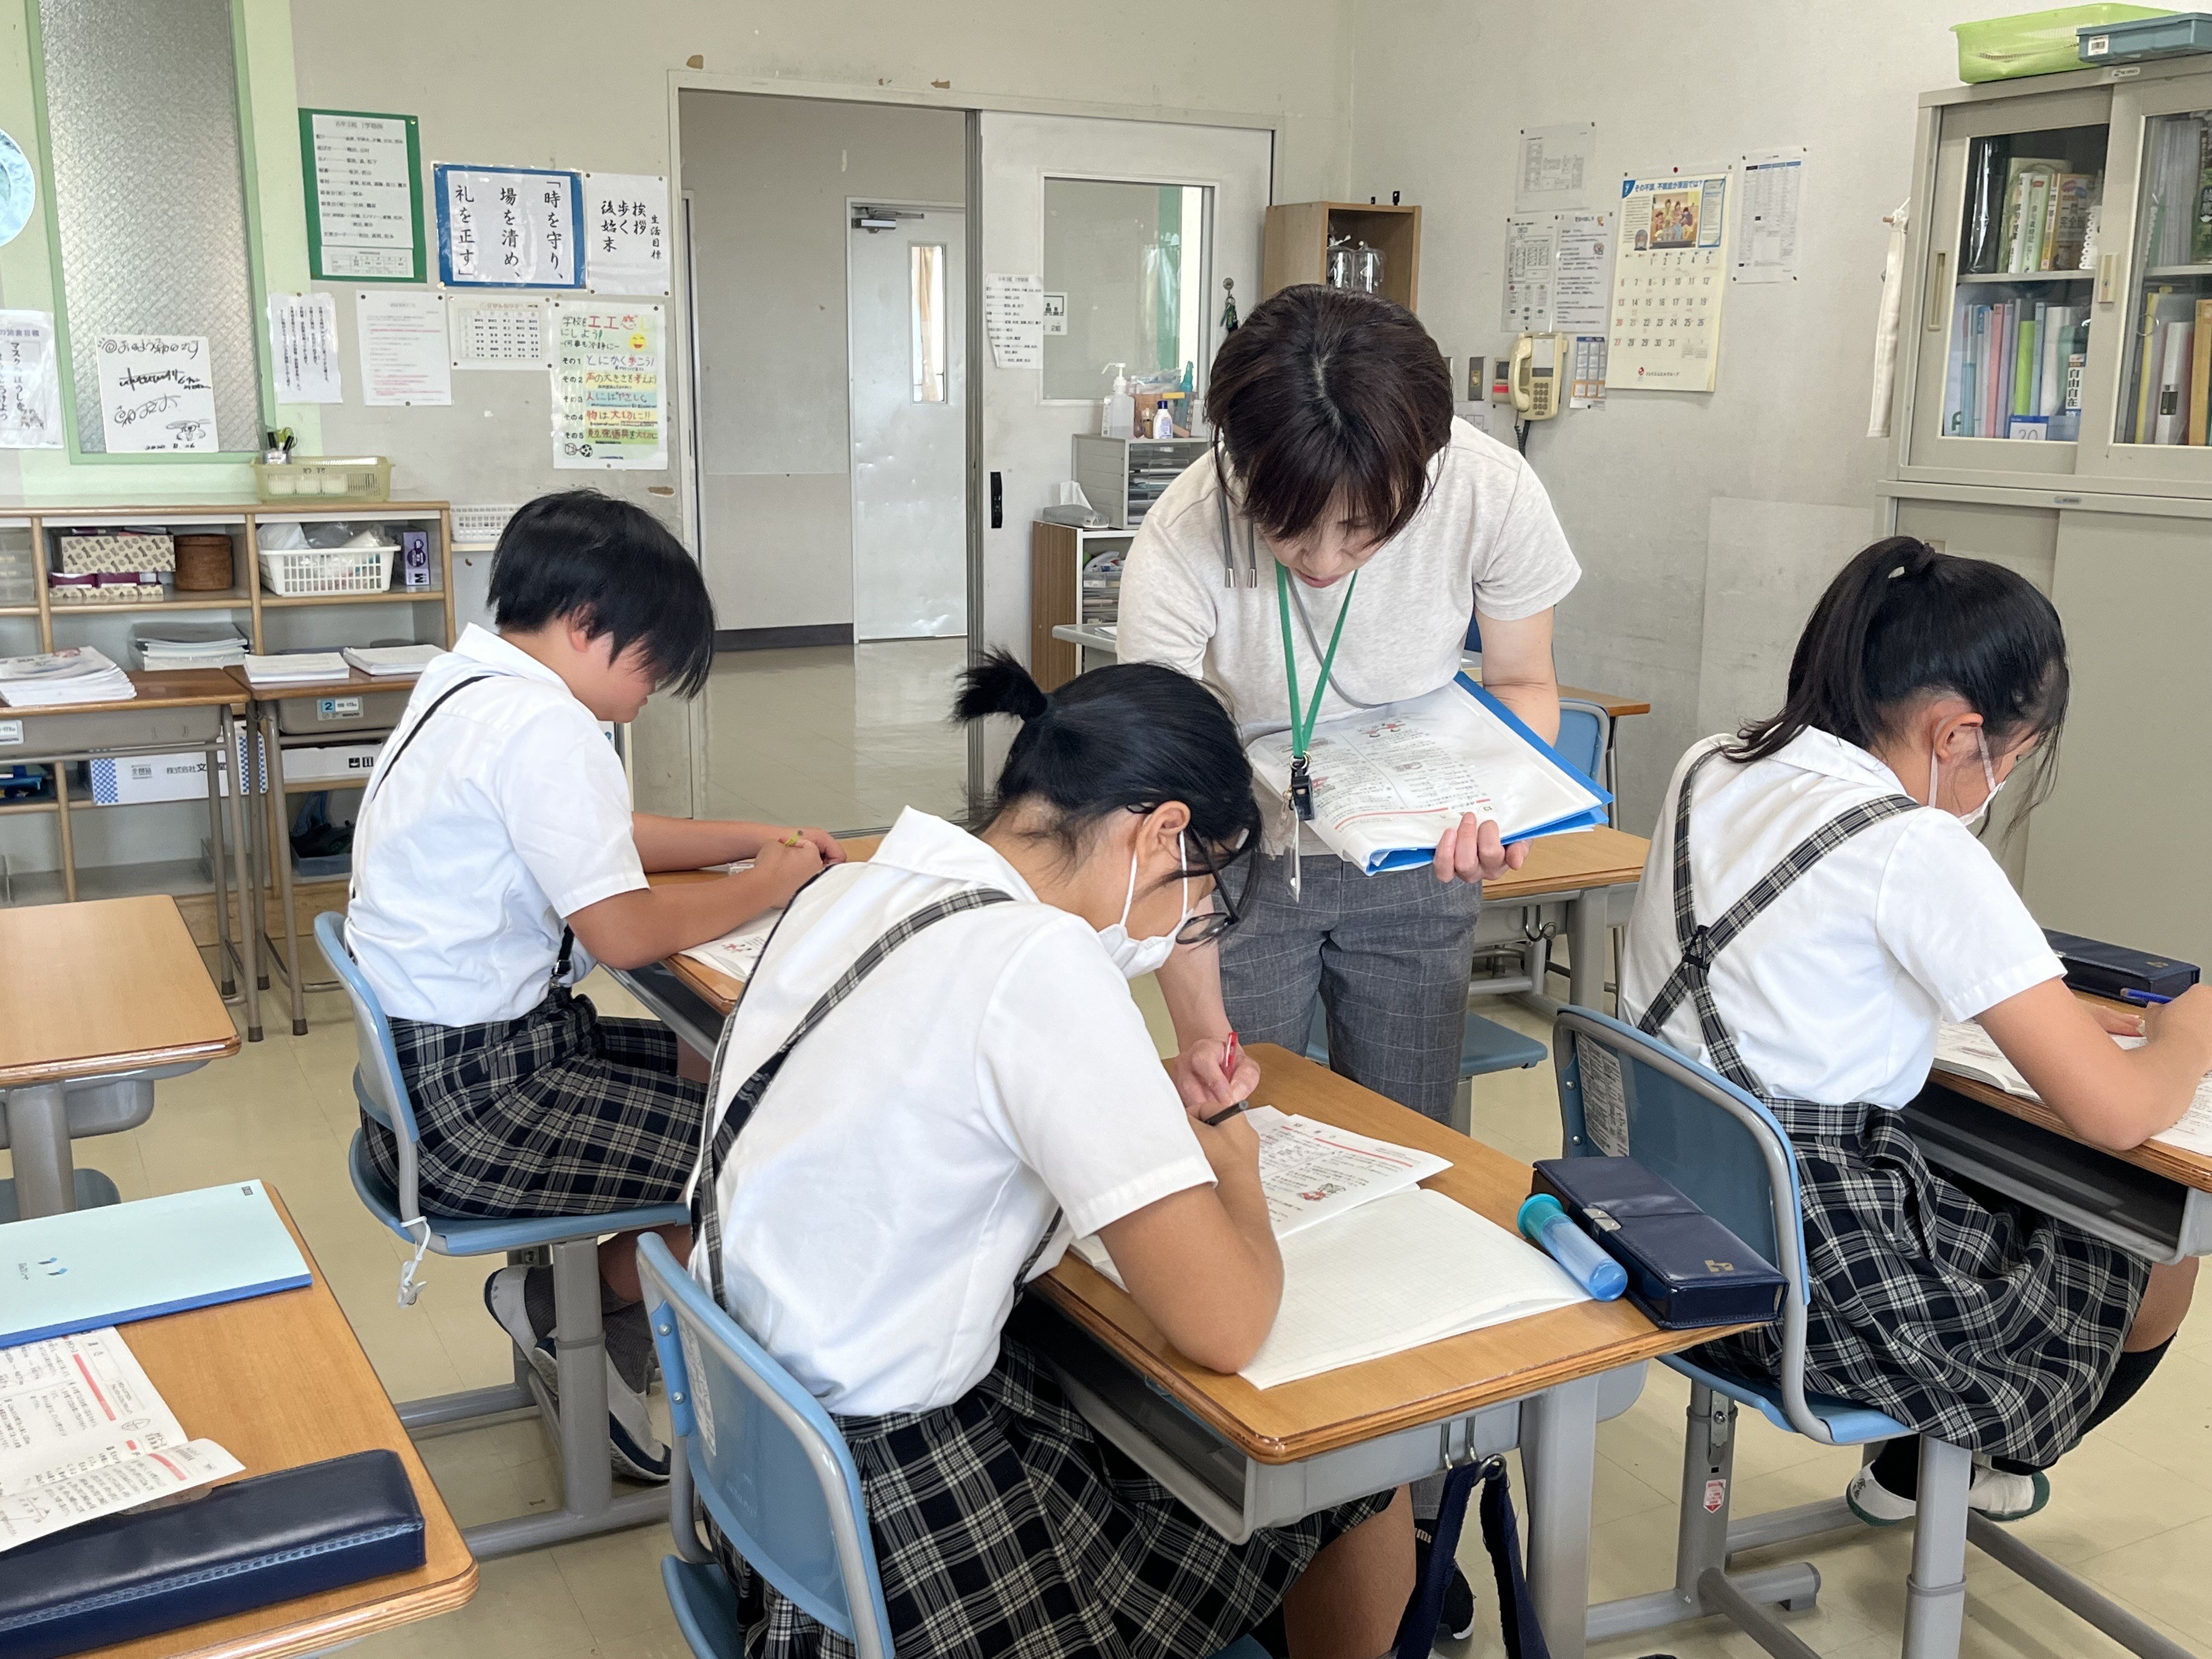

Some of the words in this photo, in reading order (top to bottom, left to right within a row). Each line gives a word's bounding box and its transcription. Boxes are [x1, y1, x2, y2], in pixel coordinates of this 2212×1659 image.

[455, 185, 475, 276] 礼を正す」
[500, 188, 520, 277] 場を清め、
[544, 181, 563, 279] 「時を守り、
[600, 200, 617, 252] 後始末
[618, 200, 630, 234] 歩く
[633, 201, 647, 235] 挨拶
[1630, 318, 1636, 326] 21
[1684, 319, 1691, 327] 25
[1697, 318, 1705, 326] 26
[1655, 338, 1661, 347] 30
[2067, 368, 2080, 407] 自由自在
[415, 573, 424, 583] M
[325, 702, 332, 710] 2
